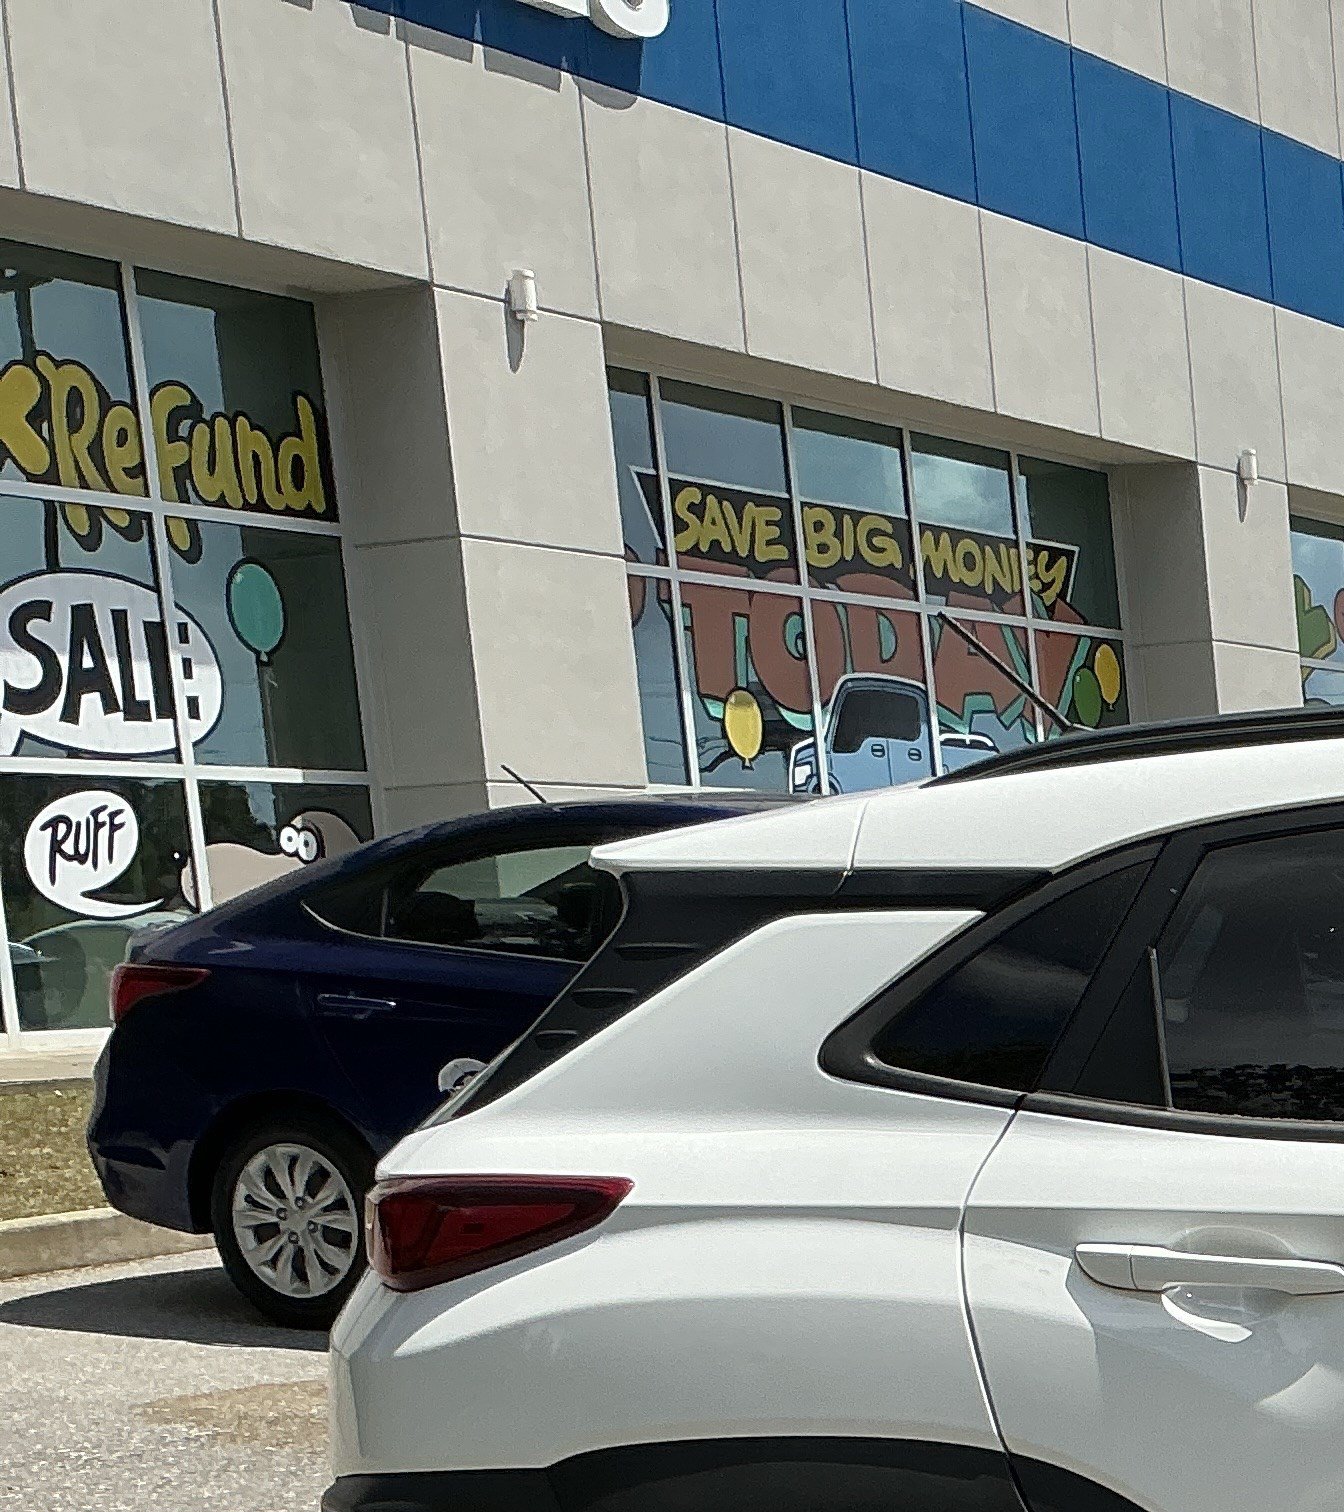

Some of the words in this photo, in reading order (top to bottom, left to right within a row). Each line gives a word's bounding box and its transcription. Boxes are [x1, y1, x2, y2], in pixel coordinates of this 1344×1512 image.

[36, 354, 327, 552] Refund
[673, 486, 789, 563] SAVE
[801, 505, 903, 569] BIG
[912, 529, 1068, 606] MONEY
[1, 598, 202, 726] SALE
[657, 552, 1088, 740] TODAY
[39, 803, 127, 886] RUFF
